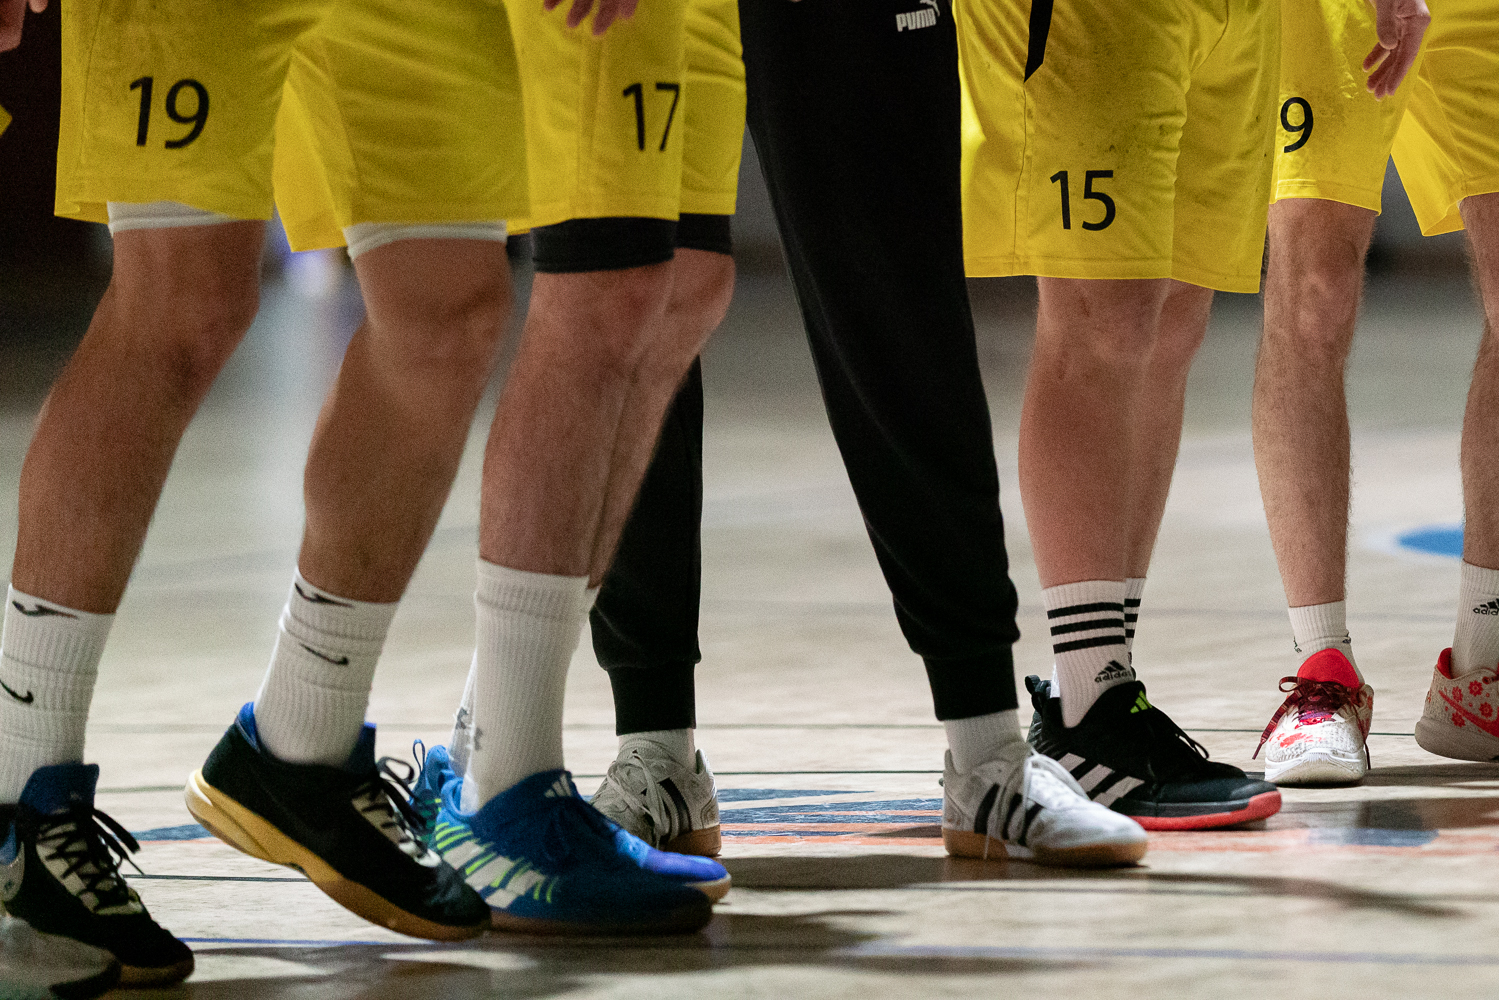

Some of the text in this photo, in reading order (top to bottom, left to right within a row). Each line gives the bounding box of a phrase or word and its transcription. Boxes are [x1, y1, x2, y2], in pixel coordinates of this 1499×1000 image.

[895, 7, 937, 32] PUMA
[129, 75, 210, 150] 19
[623, 82, 680, 152] 17
[1280, 96, 1314, 154] 9
[1050, 169, 1117, 232] 15
